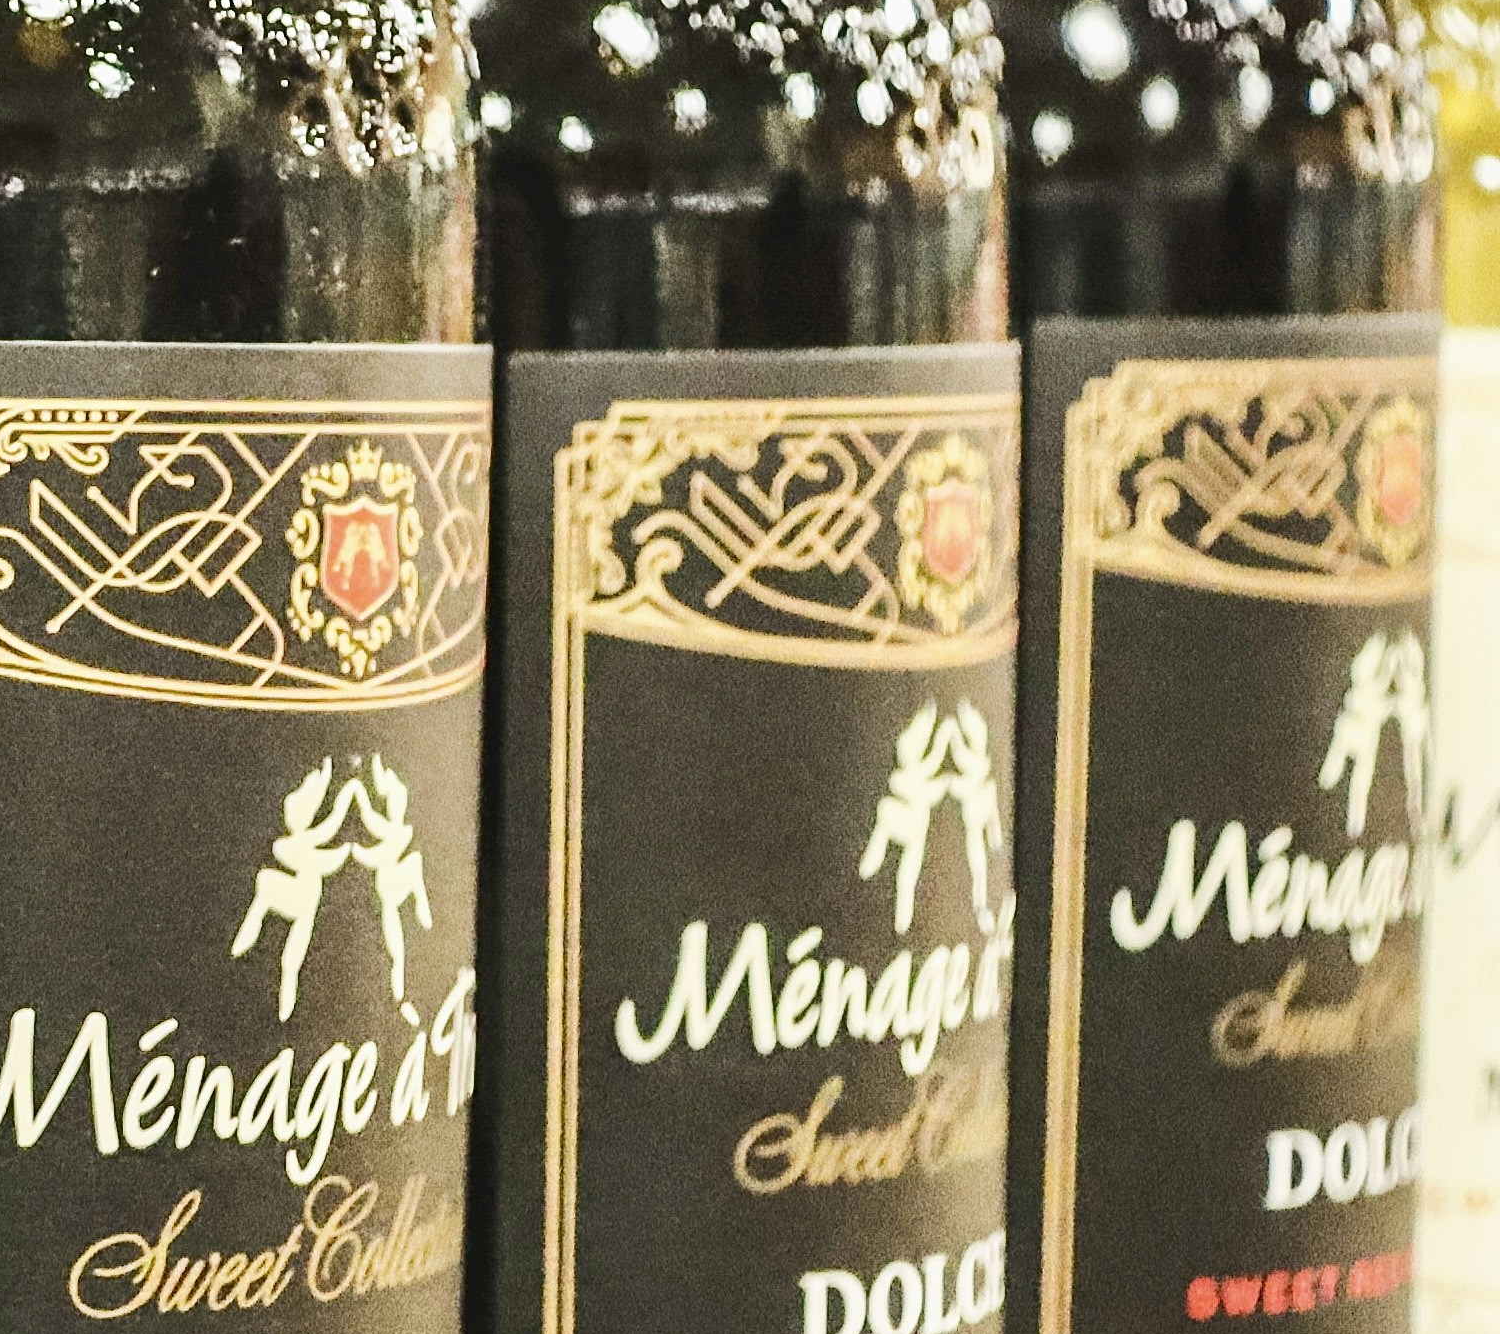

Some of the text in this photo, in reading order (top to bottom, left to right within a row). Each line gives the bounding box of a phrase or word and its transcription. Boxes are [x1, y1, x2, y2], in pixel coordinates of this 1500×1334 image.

[390, 1001, 431, 1126] à
[615, 921, 970, 1077] Ménage
[69, 1189, 305, 1319] Sweet
